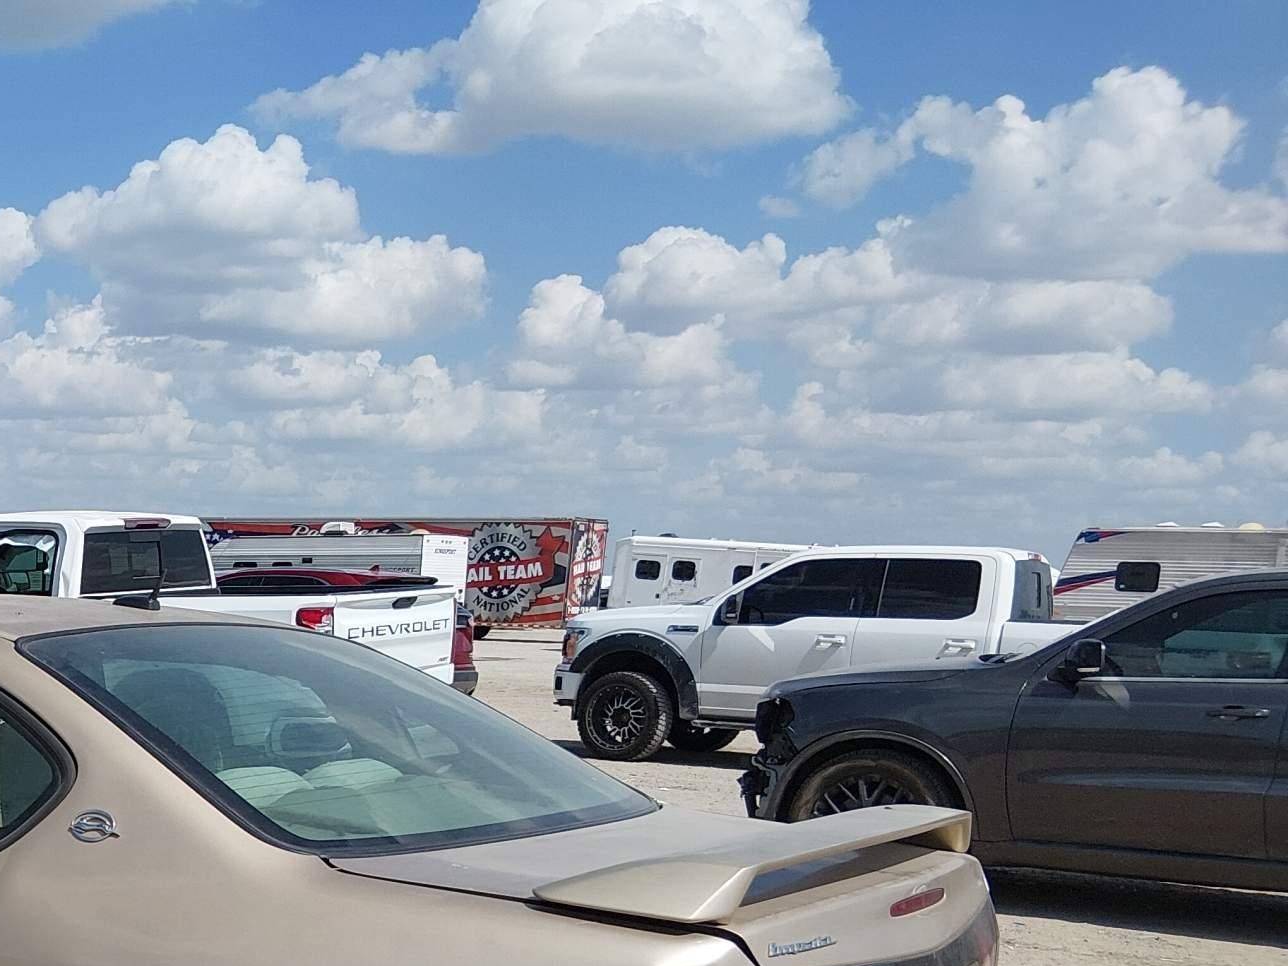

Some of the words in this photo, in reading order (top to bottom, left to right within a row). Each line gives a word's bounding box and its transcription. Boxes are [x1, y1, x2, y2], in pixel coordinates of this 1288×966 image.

[468, 533, 527, 561] CERTIFIED
[467, 566, 492, 584] AIL
[497, 562, 543, 580] TEAM
[473, 587, 530, 612] NATIONAL
[348, 618, 450, 639] CHEVROLET
